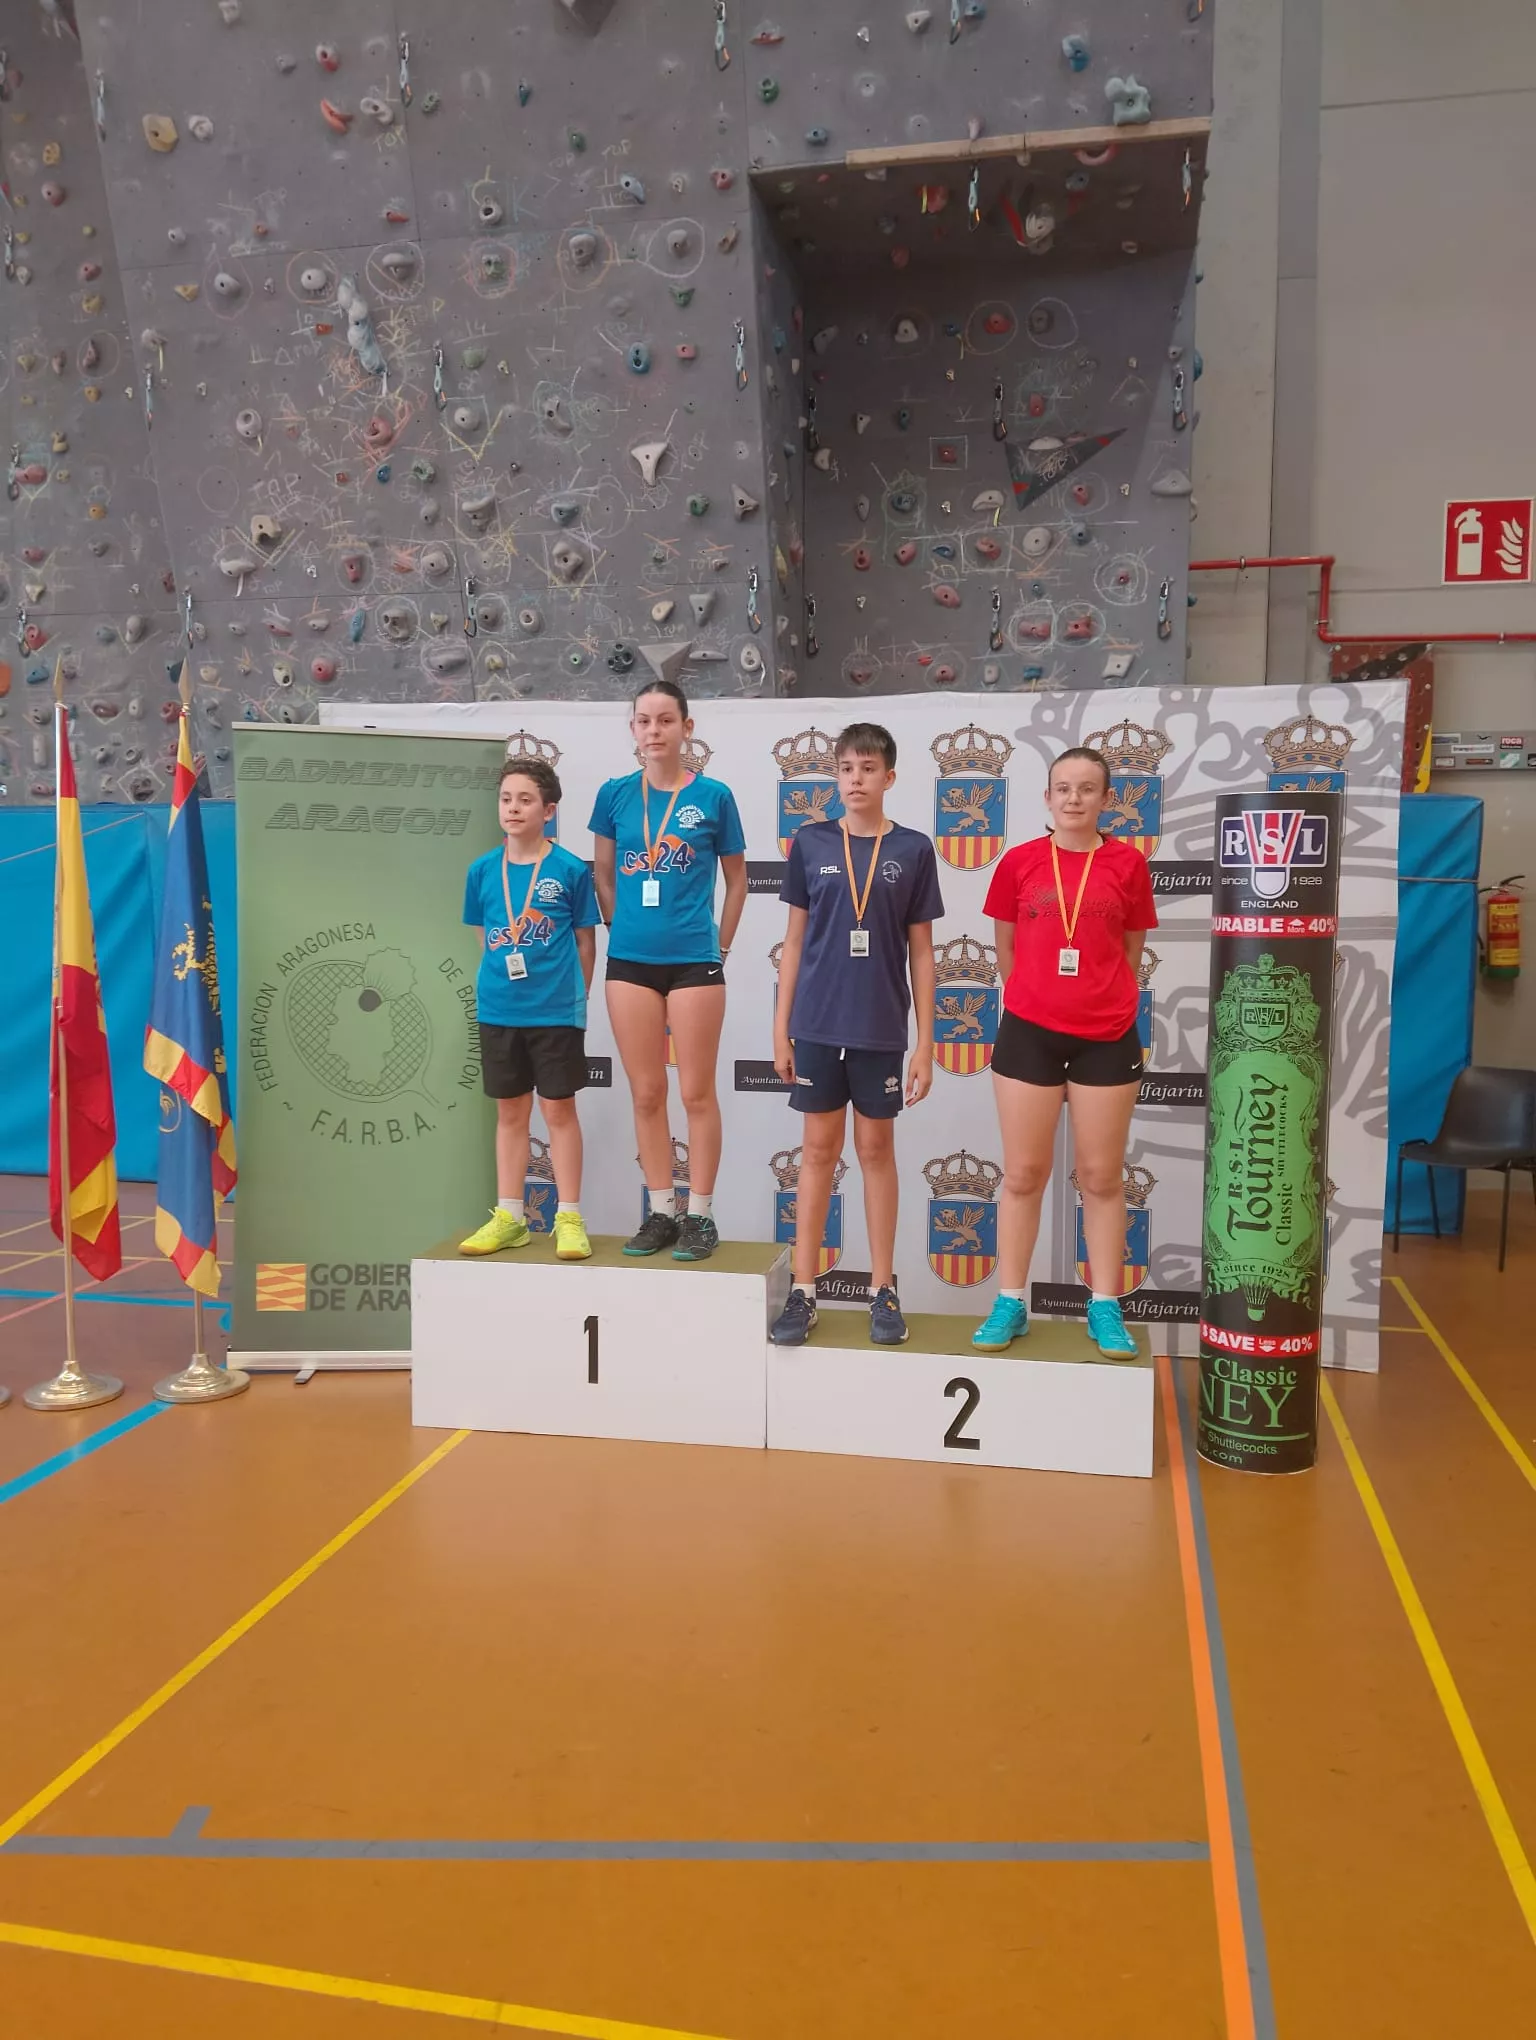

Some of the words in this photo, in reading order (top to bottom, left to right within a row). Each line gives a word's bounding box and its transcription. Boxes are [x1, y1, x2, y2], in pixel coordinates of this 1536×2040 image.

[237, 756, 502, 791] BADMINTON
[265, 802, 472, 836] ARAGON
[820, 865, 841, 875] RSL
[1221, 875, 1249, 885] since
[1241, 900, 1299, 909] ENGLAND
[1308, 918, 1336, 933] 40%
[250, 981, 279, 1092] FEDERACION
[276, 922, 376, 977] ARAGONESA
[438, 957, 463, 983] DE
[1137, 1082, 1204, 1101] lfajarín
[310, 1109, 436, 1146] F.A.R.B.A.
[1226, 1073, 1289, 1241] Tourney
[1275, 1183, 1293, 1246] Classic
[1223, 1263, 1256, 1273] since
[1261, 1265, 1290, 1278] 1928
[309, 1289, 346, 1311] DE
[1121, 1299, 1200, 1319] Alfajarín
[583, 1315, 599, 1384] 1
[1208, 1327, 1255, 1351] SAVE
[1280, 1335, 1313, 1353] 40%
[1214, 1358, 1297, 1386] Classic
[943, 1376, 981, 1451] 2
[1207, 1431, 1277, 1455] Shuttlecocks
